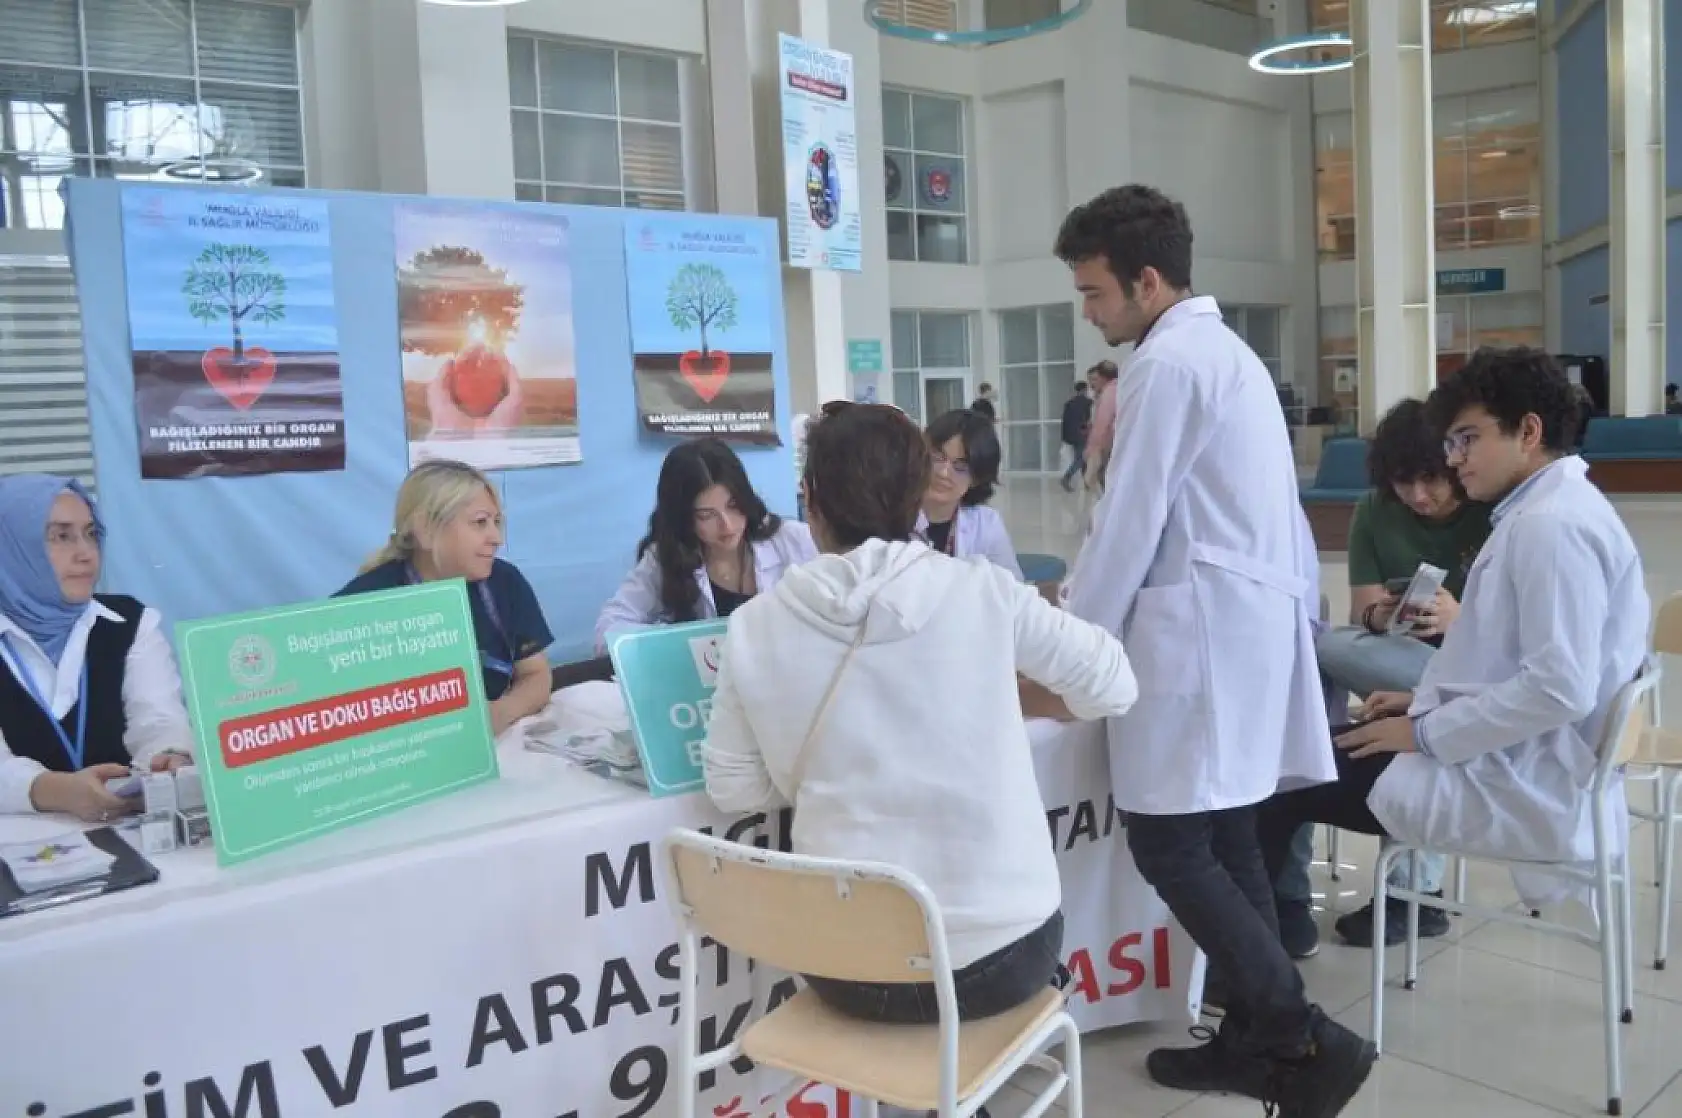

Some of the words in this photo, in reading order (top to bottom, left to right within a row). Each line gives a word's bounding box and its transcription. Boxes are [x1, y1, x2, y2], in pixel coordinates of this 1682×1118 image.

[289, 422, 336, 434] ORGAN
[287, 624, 371, 653] Bağışlanan
[374, 619, 399, 635] her
[402, 612, 444, 632] organ
[329, 644, 366, 673] yeni
[369, 640, 392, 660] bir
[228, 715, 294, 753] ORGAN
[294, 711, 319, 737] VE
[321, 700, 369, 730] DOKU
[371, 687, 418, 719] BAĞIŞ
[418, 677, 463, 705] KARTI
[302, 1014, 438, 1109] VE
[609, 1045, 668, 1118] 9
